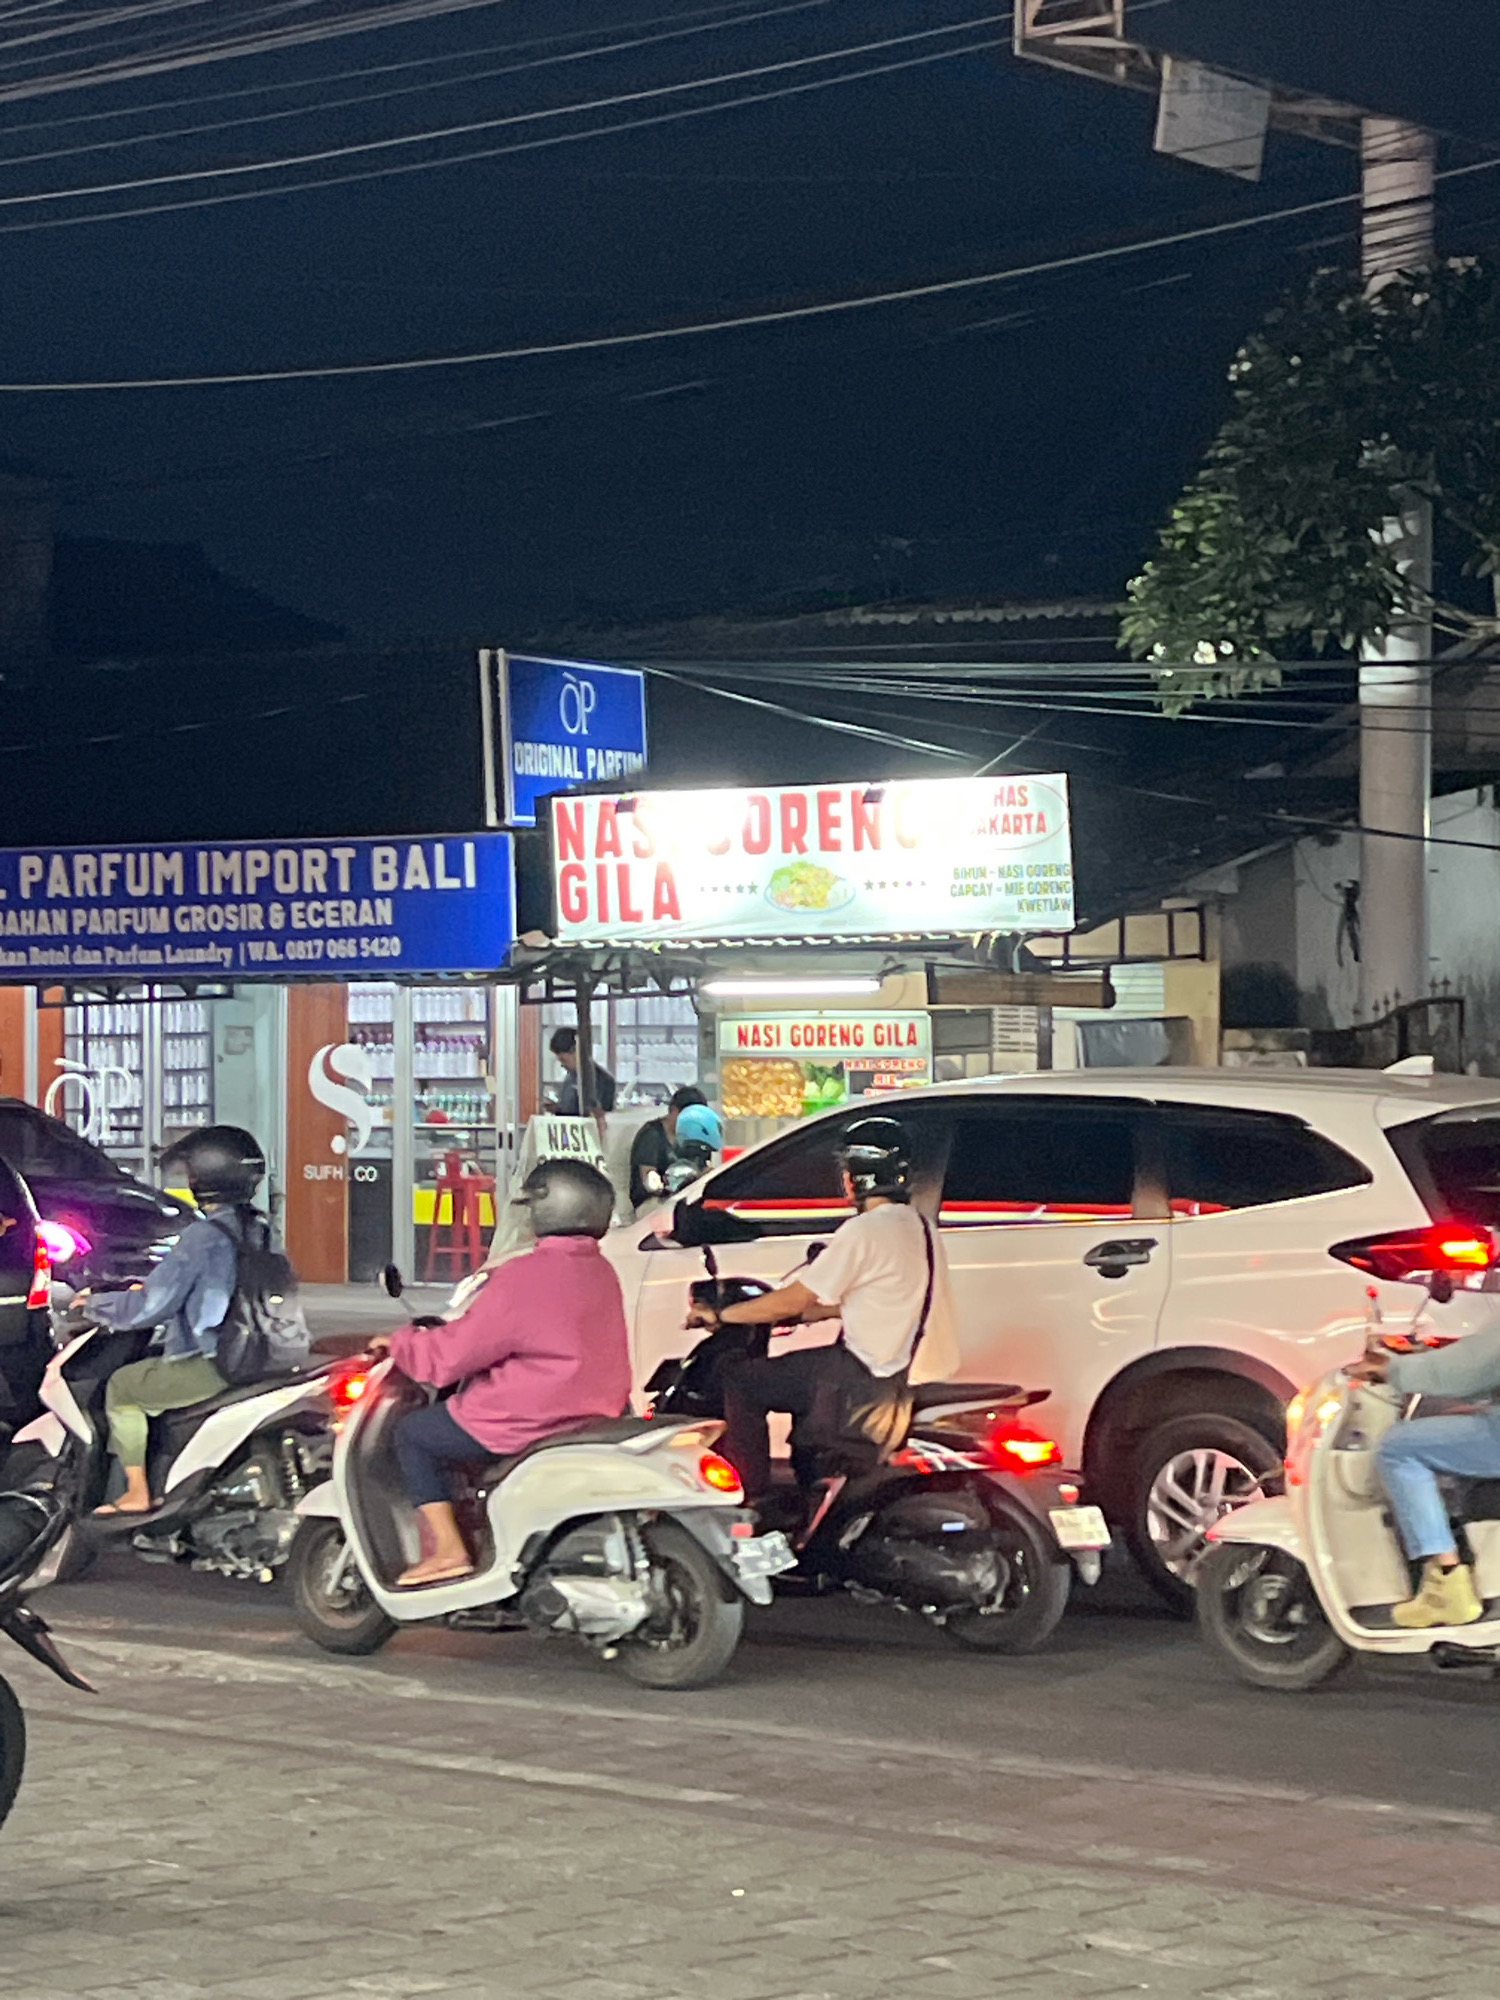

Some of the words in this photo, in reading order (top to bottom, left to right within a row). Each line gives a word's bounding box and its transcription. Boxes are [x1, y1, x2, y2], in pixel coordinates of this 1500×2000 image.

[514, 741, 584, 779] ORIGINAL
[556, 798, 656, 861] NAS
[706, 789, 922, 857] OREN
[970, 811, 1047, 835] AKARTA
[20, 851, 184, 899] PARFUM
[197, 847, 357, 897] IMPORT
[371, 841, 476, 892] BALI
[998, 865, 1024, 879] NASI
[1026, 863, 1071, 878] GORENG
[559, 861, 682, 924] GILA
[950, 882, 993, 897] CAPCAY
[1004, 881, 1024, 896] MIE
[1027, 881, 1071, 895] GORENG
[0, 908, 68, 936] AHAN
[72, 906, 170, 935] PARFUM
[174, 903, 265, 932] GROSIR
[268, 901, 286, 929] &
[291, 897, 393, 929] ECERAN
[72, 944, 103, 965] dan
[104, 944, 163, 966] Parfum
[164, 941, 233, 968] Laundry
[359, 935, 401, 957] 5420
[737, 1024, 782, 1048] NASI
[790, 1023, 864, 1048] GORENG
[873, 1021, 918, 1047] GILA
[547, 1122, 589, 1153] NASI
